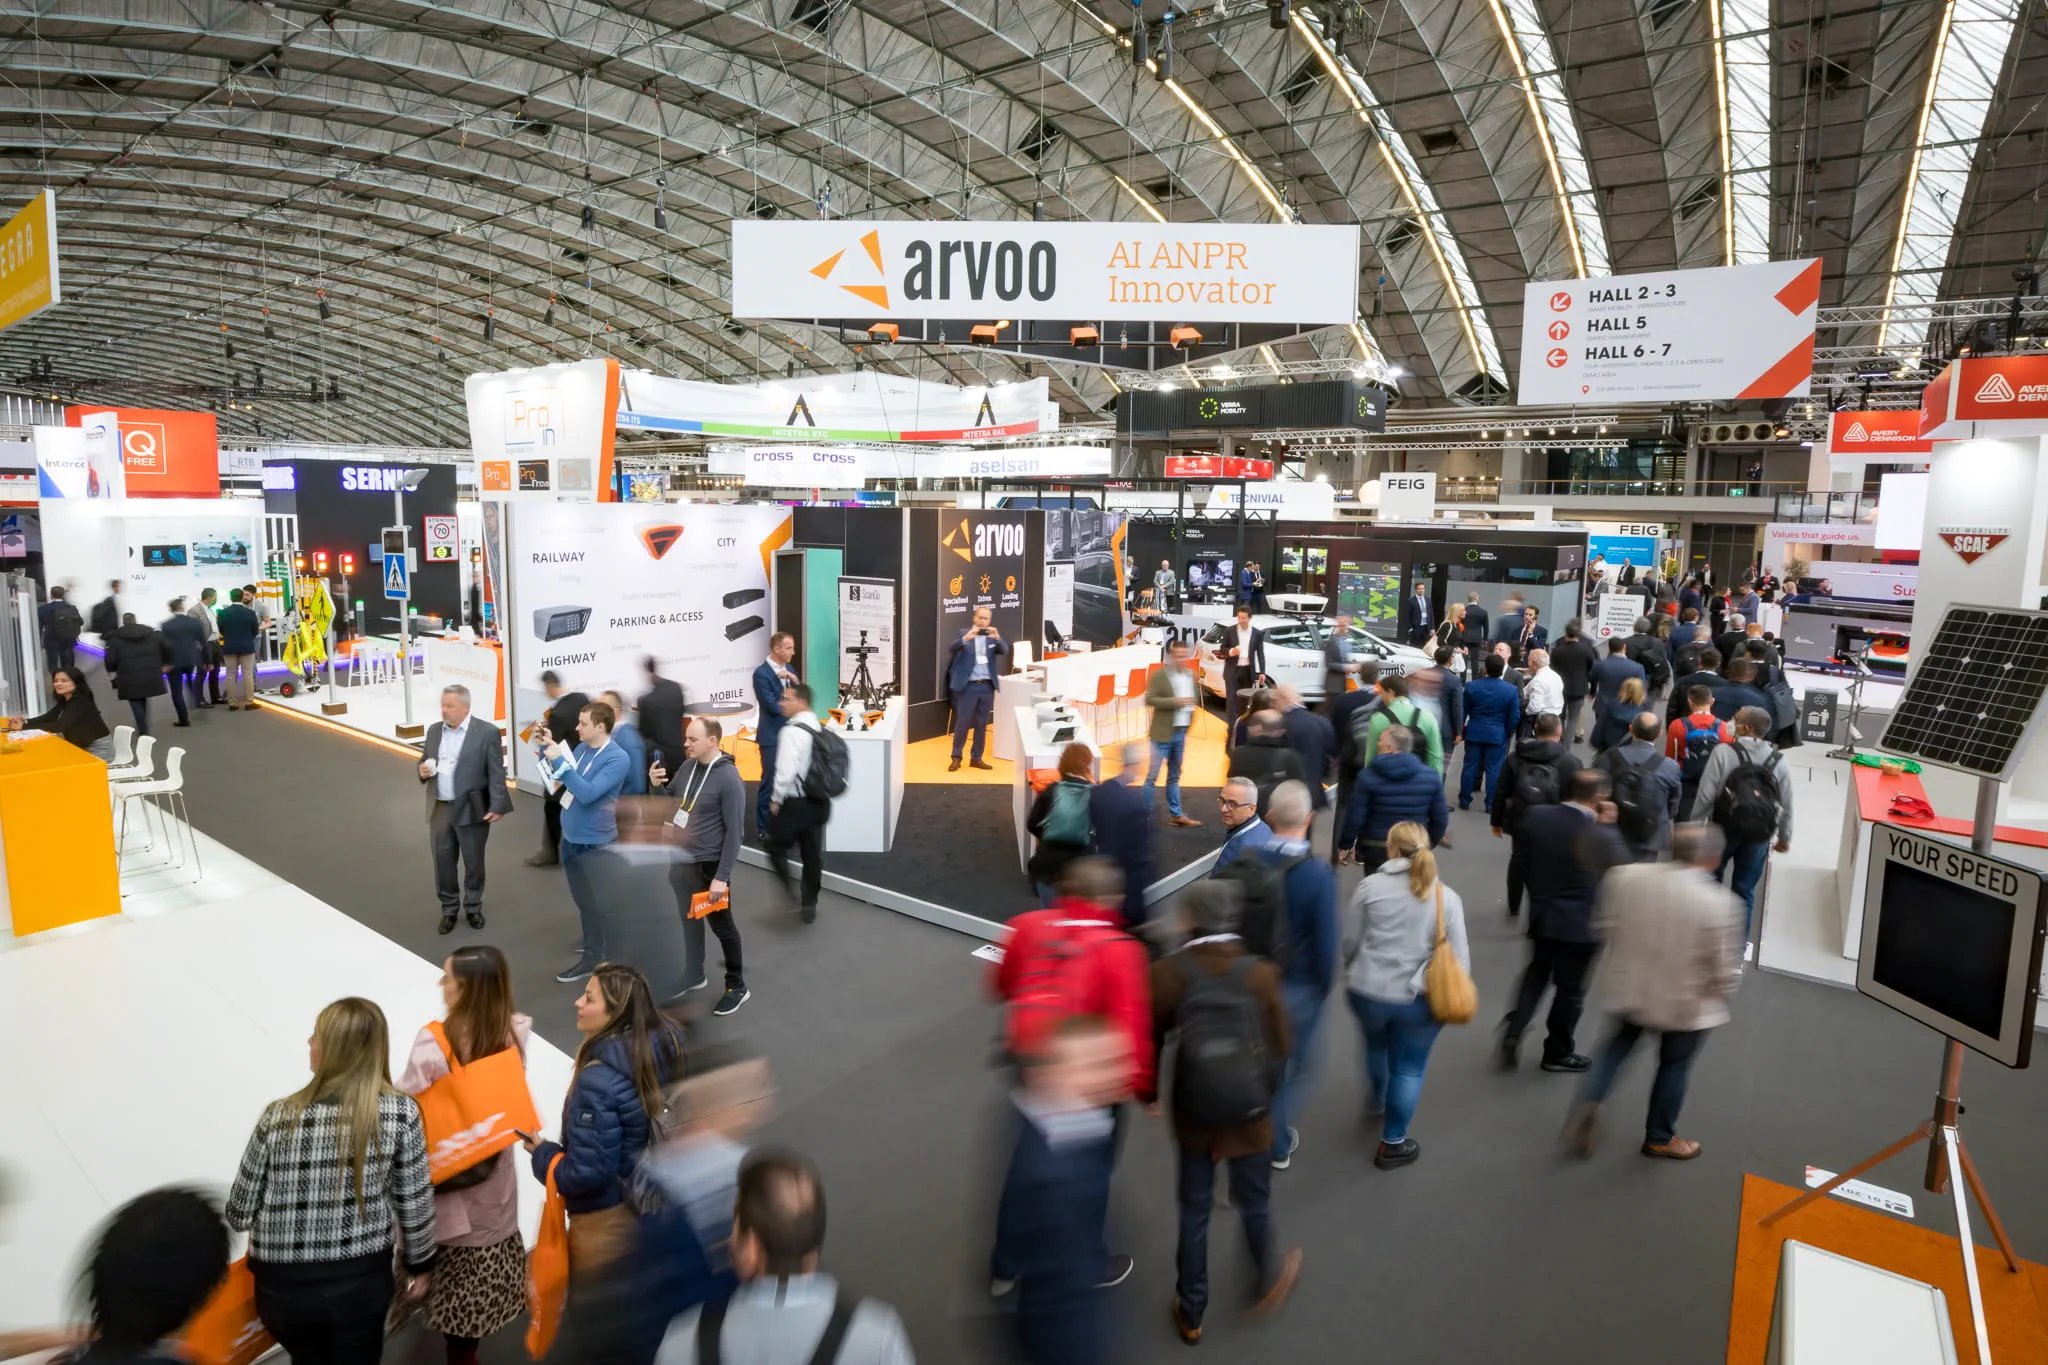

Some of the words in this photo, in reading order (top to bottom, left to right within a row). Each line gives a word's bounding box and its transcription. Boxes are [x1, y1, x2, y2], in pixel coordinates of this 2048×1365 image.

[1106, 241, 1142, 269] AI
[1149, 242, 1250, 271] ANPR
[904, 240, 1057, 301] arvoo
[1107, 276, 1278, 306] Innovator
[1589, 287, 1632, 303] HALL
[1638, 286, 1649, 299] 2
[1666, 284, 1677, 298] 3
[1587, 318, 1630, 332] HALL
[1636, 316, 1647, 329] 5
[1585, 346, 1628, 360] HALL
[1634, 345, 1645, 358] 6
[1662, 344, 1672, 356] 7
[2018, 385, 2048, 393] AVE
[2017, 394, 2048, 402] DEN
[772, 429, 809, 438] INTETRA
[962, 429, 991, 438] INTETRA
[992, 427, 1007, 437] RAIL
[125, 430, 156, 457] Q
[127, 457, 156, 466] FREE
[753, 451, 793, 462] cross
[813, 452, 856, 464] cross
[969, 455, 1040, 474] aselsan
[1388, 478, 1425, 489] FEIG
[437, 527, 447, 536] 70
[1619, 525, 1659, 536] FEIG
[1772, 530, 1799, 539] Values
[1801, 531, 1819, 539] that
[1821, 532, 1846, 541] guide
[717, 537, 737, 547] CITY
[974, 523, 1025, 557] arvoo
[1953, 535, 1990, 552] SCAE
[532, 551, 586, 564] RAILWAY
[610, 615, 656, 629] PARKING
[659, 614, 667, 624] &
[669, 611, 704, 623] ACCESS
[541, 652, 597, 668] HIGHWAY
[710, 688, 744, 702] MOBILE
[1888, 832, 1941, 872] YOUR
[1945, 853, 2019, 898] SPEED
